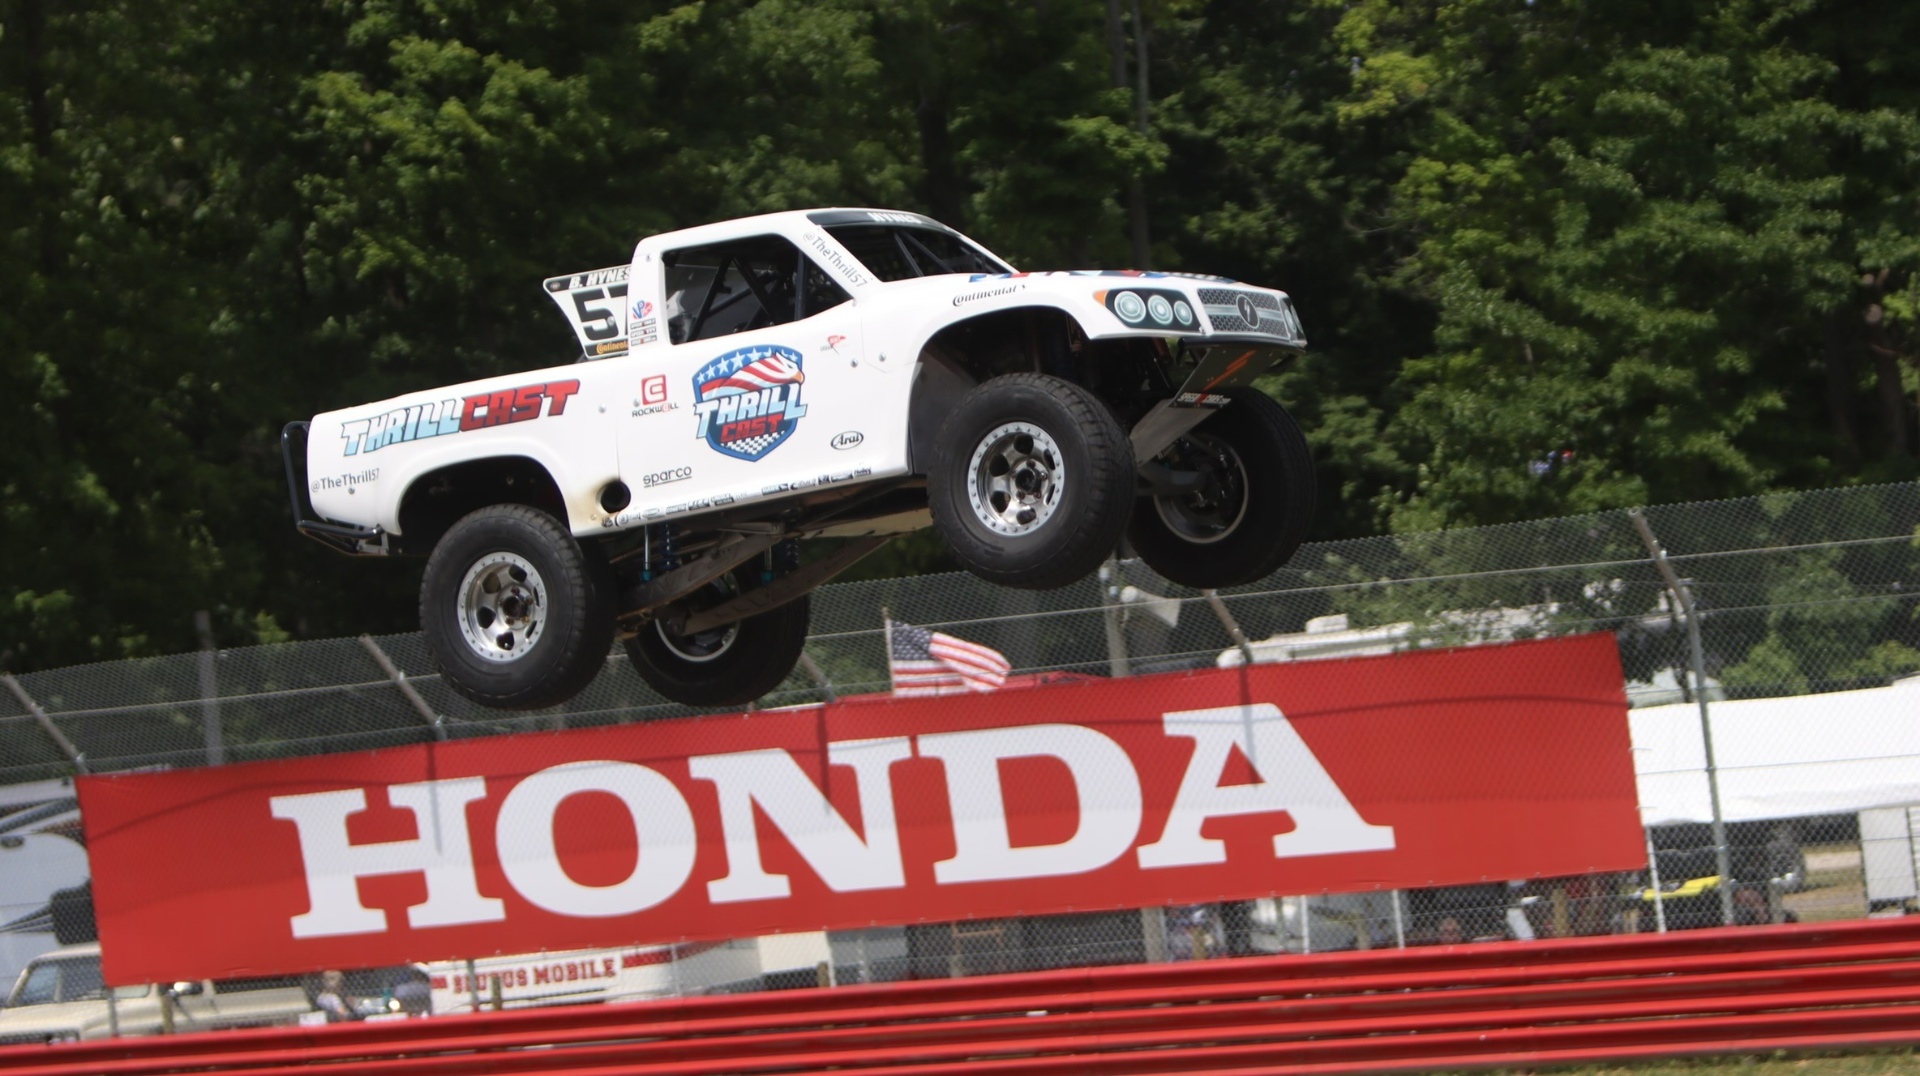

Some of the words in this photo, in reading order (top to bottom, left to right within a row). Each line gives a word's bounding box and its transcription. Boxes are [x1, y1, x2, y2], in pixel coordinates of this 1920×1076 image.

[803, 231, 868, 287] @TheThrill57
[568, 274, 584, 290] B.
[586, 266, 632, 286] HYNES
[952, 284, 1017, 307] Continental
[596, 340, 629, 355] Continent
[693, 382, 808, 439] THRILL
[720, 414, 783, 443] CAST
[311, 467, 380, 493] @TheThrill57
[643, 466, 692, 488] sparco
[270, 703, 1395, 939] HONDA
[534, 958, 616, 985] MOBILE
